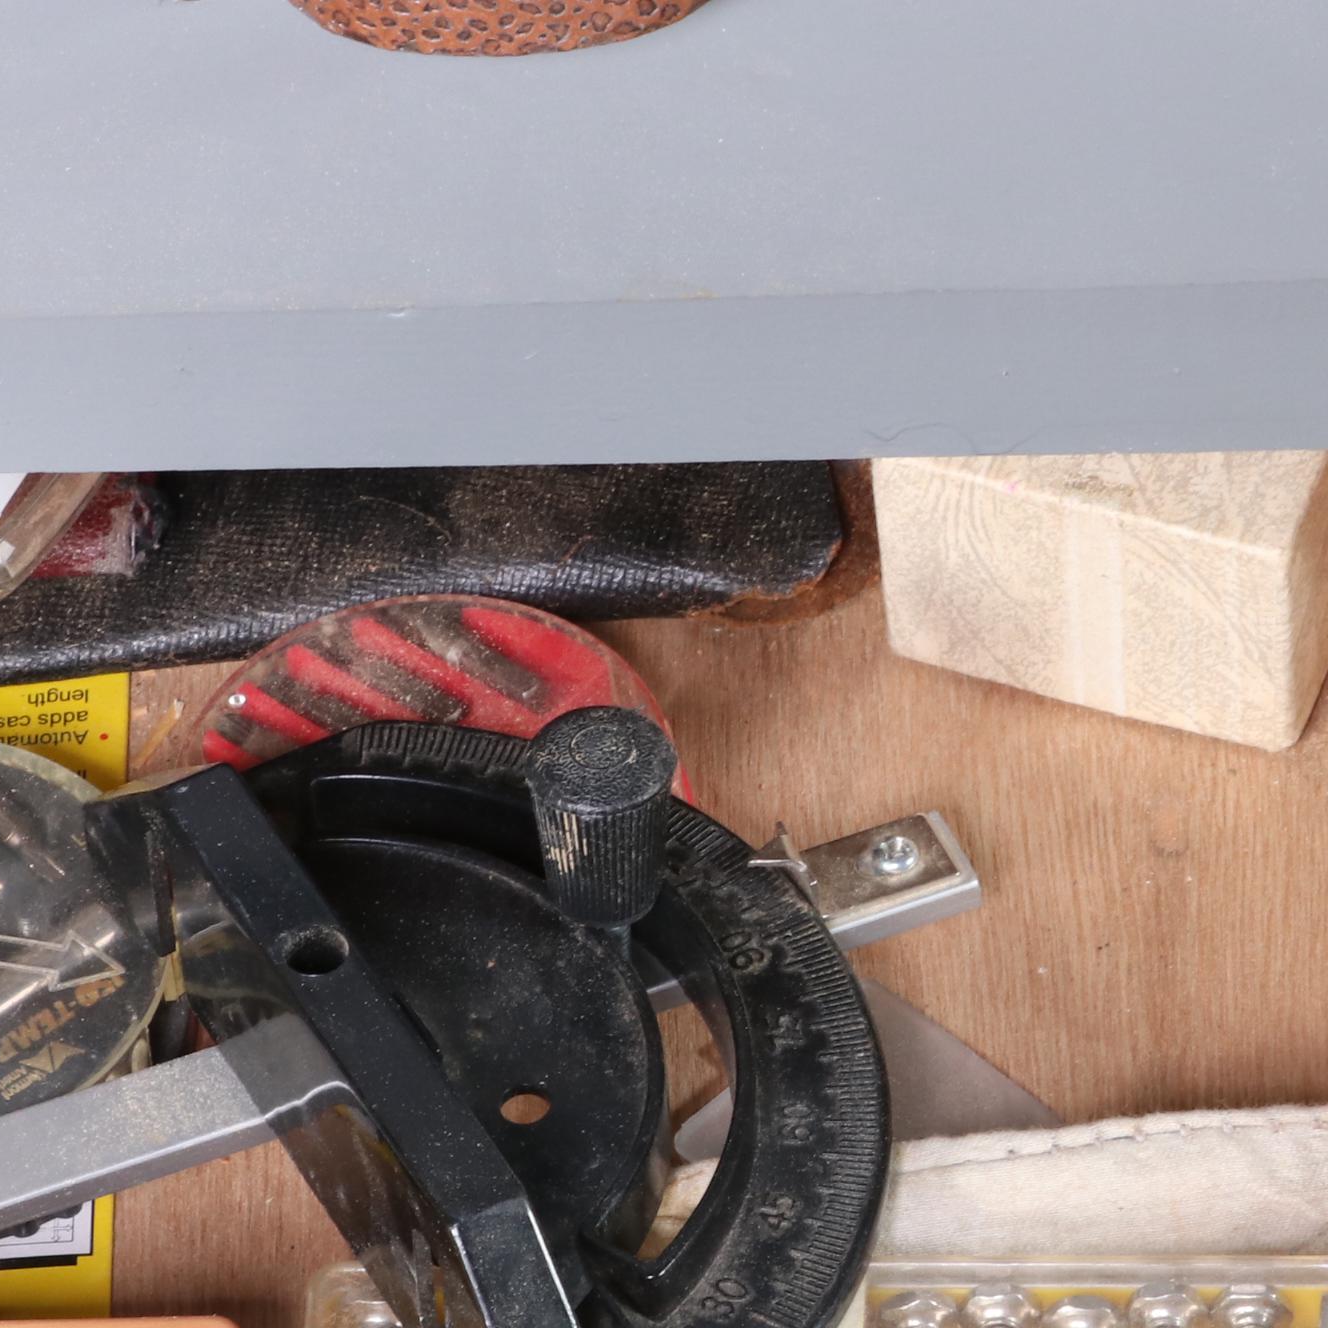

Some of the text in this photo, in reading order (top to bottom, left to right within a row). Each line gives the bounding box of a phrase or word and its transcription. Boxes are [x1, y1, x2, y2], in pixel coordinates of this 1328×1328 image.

[38, 709, 89, 728] adds
[759, 1196, 799, 1237] 45
[700, 1276, 747, 1321] 30
